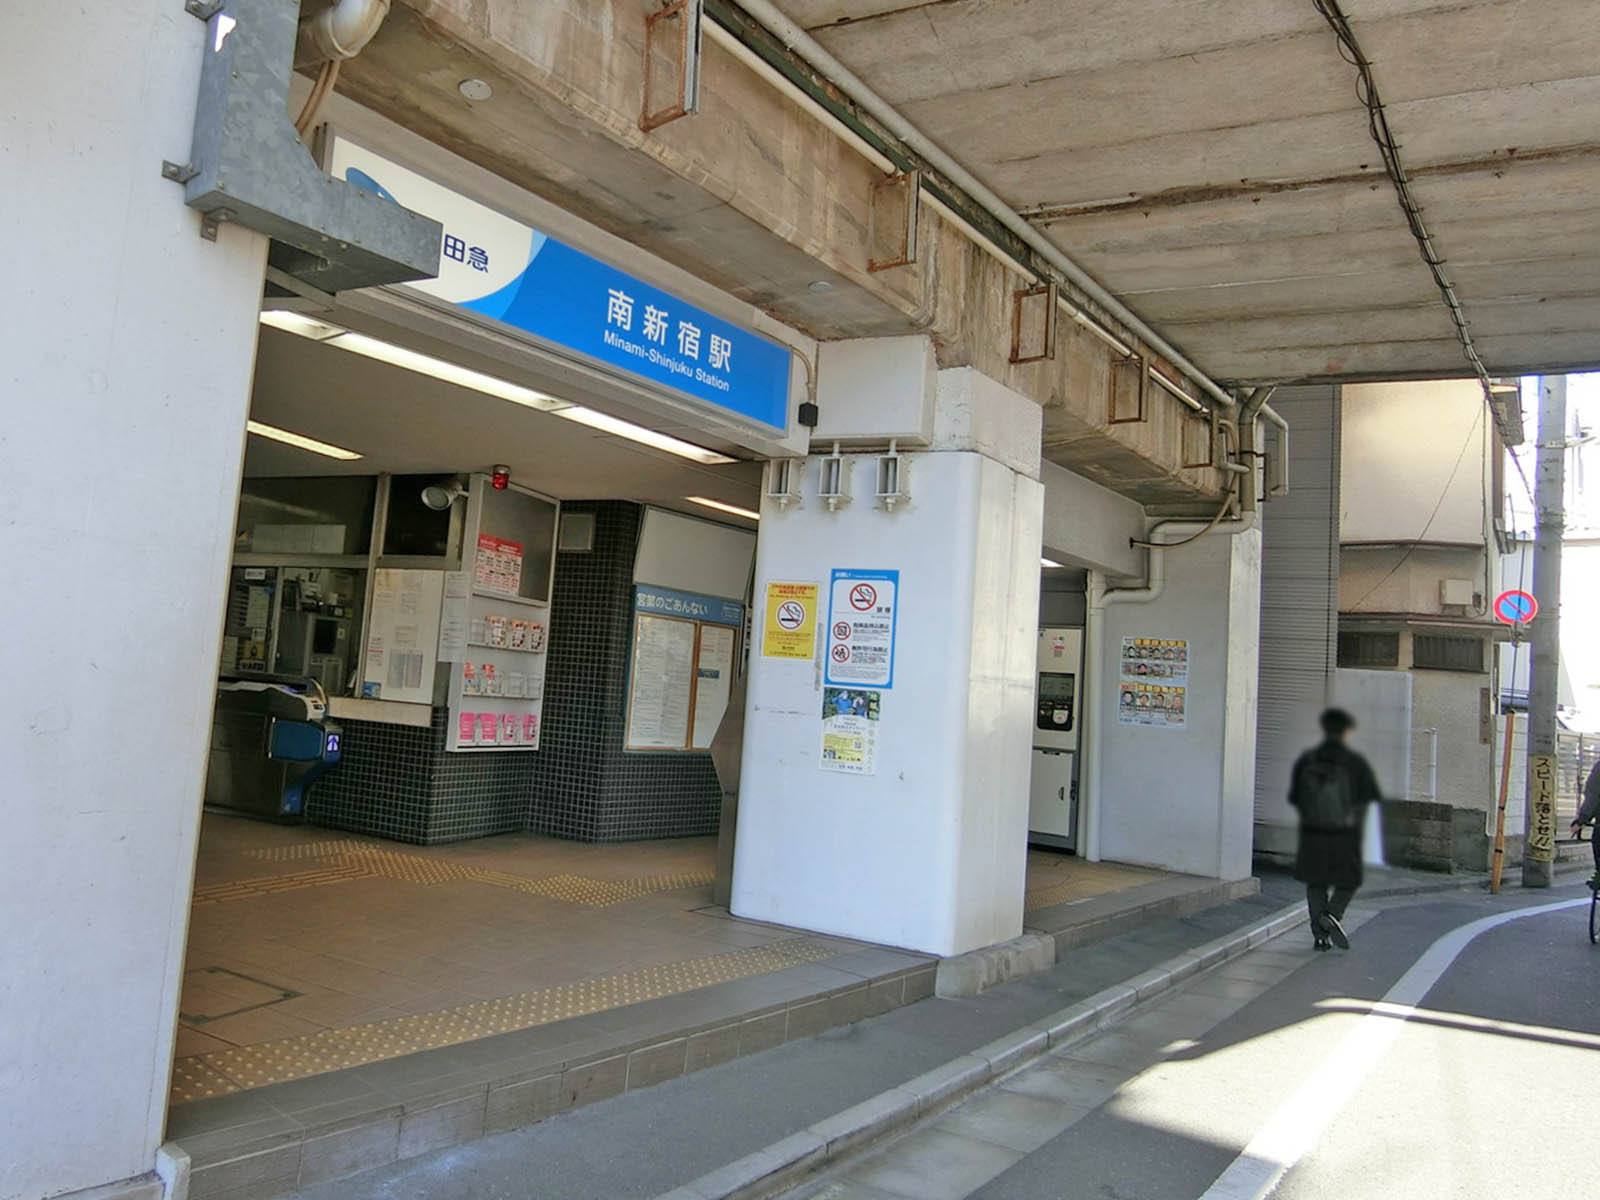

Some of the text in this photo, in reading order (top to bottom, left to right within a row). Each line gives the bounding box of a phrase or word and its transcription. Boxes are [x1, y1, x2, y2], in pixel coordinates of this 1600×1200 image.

[603, 329, 731, 392] Minami-Shinjuku Station
[607, 288, 732, 373] 南新宿駅
